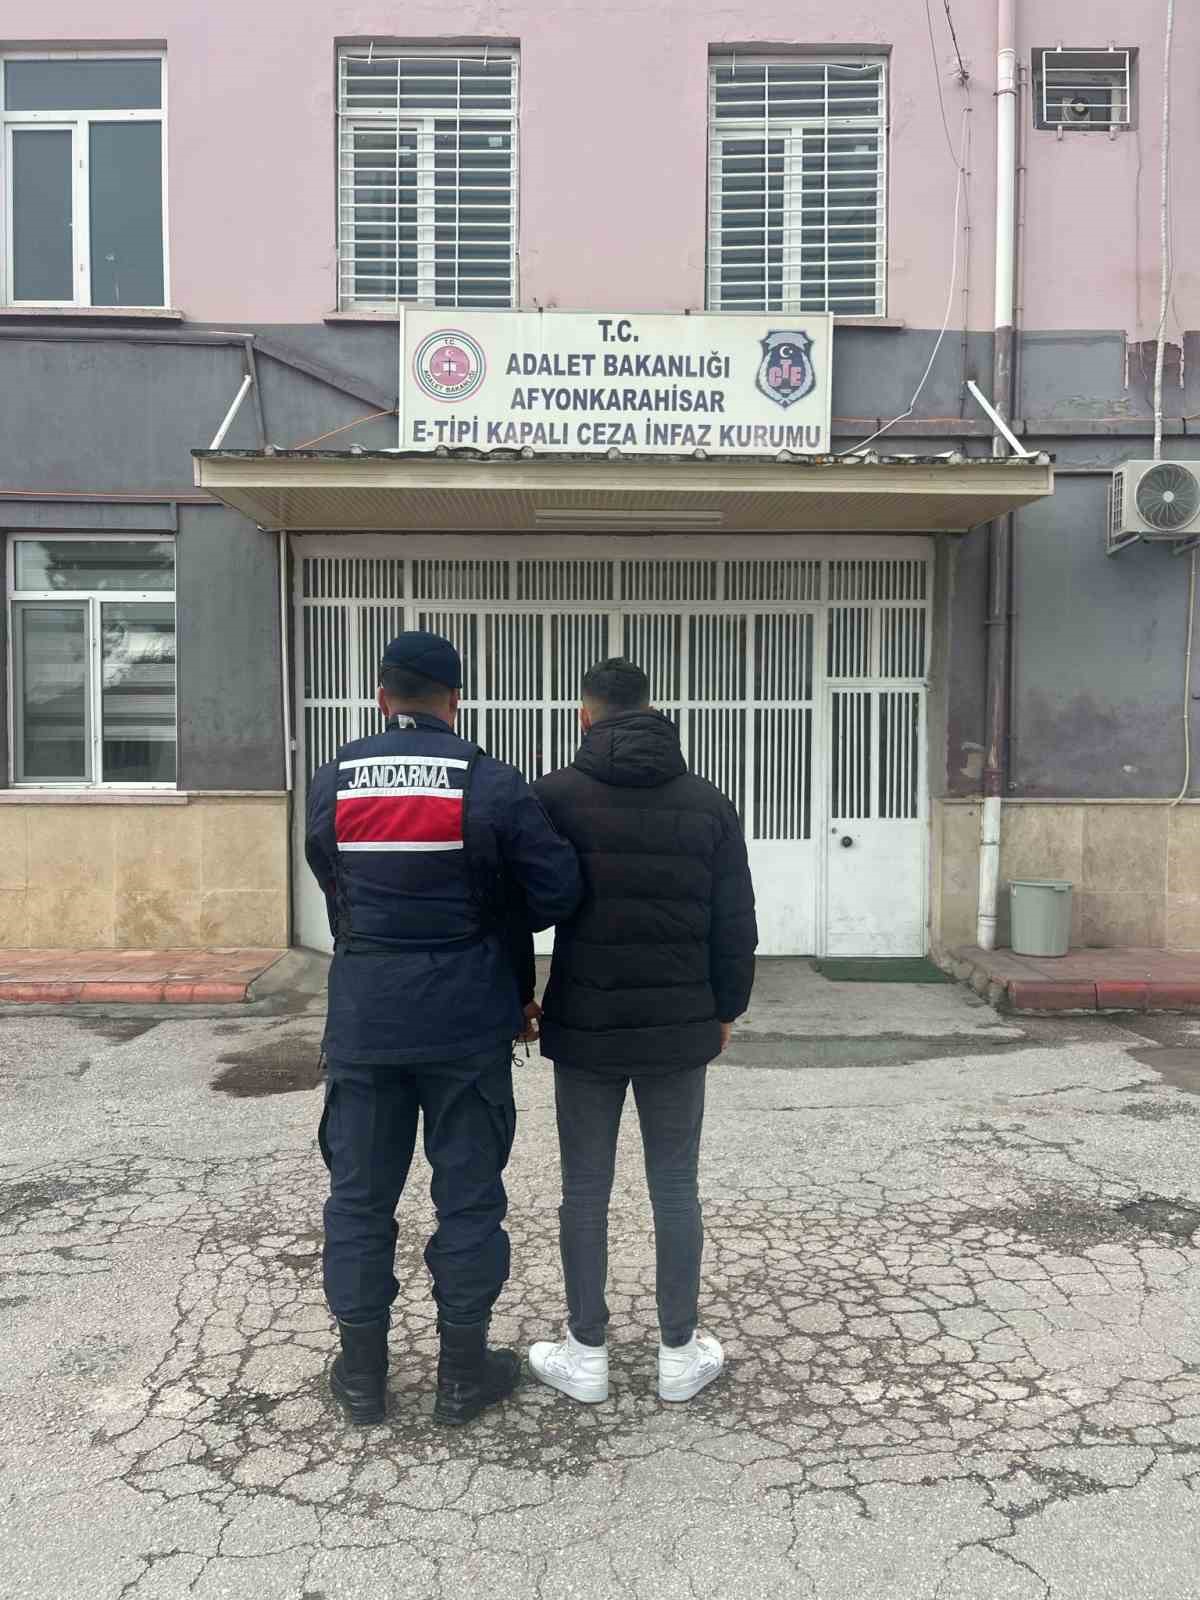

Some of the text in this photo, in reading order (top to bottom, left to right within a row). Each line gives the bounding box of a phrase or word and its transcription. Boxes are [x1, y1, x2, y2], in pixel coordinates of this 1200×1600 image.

[597, 319, 639, 343] T.C.
[505, 350, 730, 378] ADALET BAKANLIĞI
[768, 358, 802, 387] CTE
[510, 383, 725, 412] AFYONKARAHİSAR
[412, 415, 820, 448] E-TİPİ KAPALI CEZA İNFAZ KURUMU
[348, 765, 451, 789] JANDARMA
